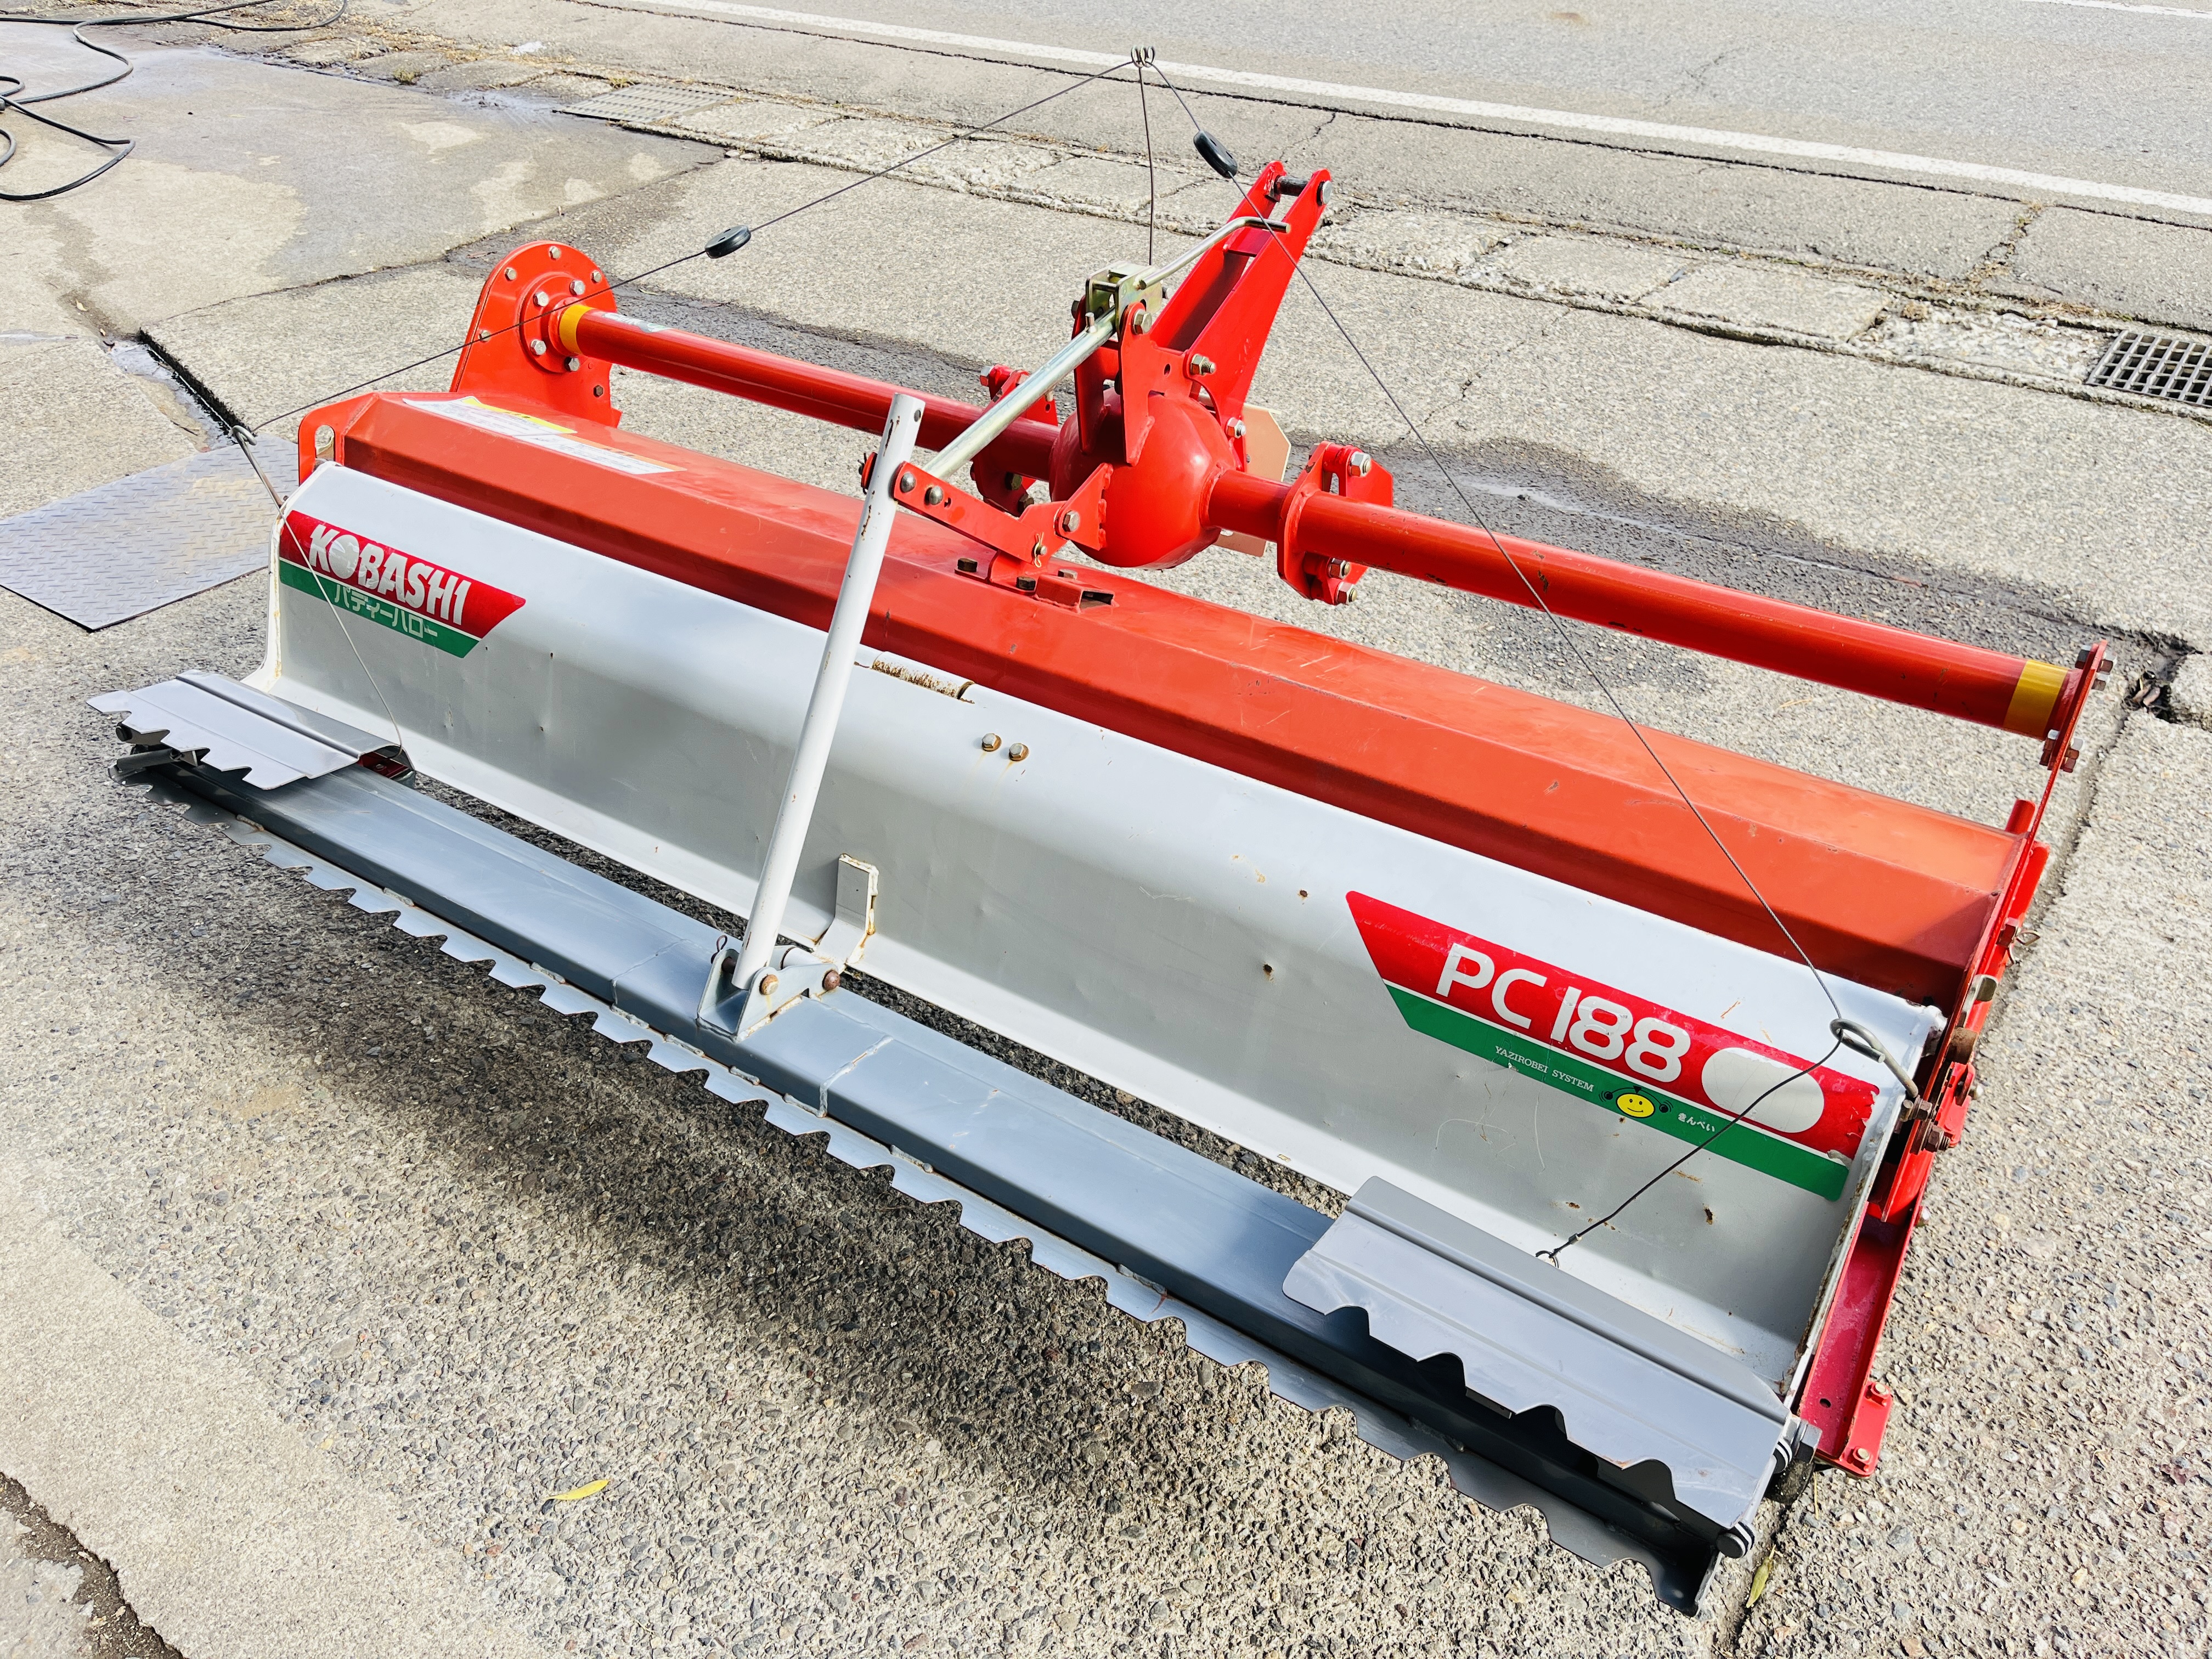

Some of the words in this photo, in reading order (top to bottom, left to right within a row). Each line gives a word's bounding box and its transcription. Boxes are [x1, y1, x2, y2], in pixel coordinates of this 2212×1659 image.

[309, 524, 471, 625] KOBASHI
[334, 584, 438, 638] パディーハロー
[1496, 1046, 1548, 1074] YAZIROBEI
[1553, 1069, 1594, 1092] SYSTEM
